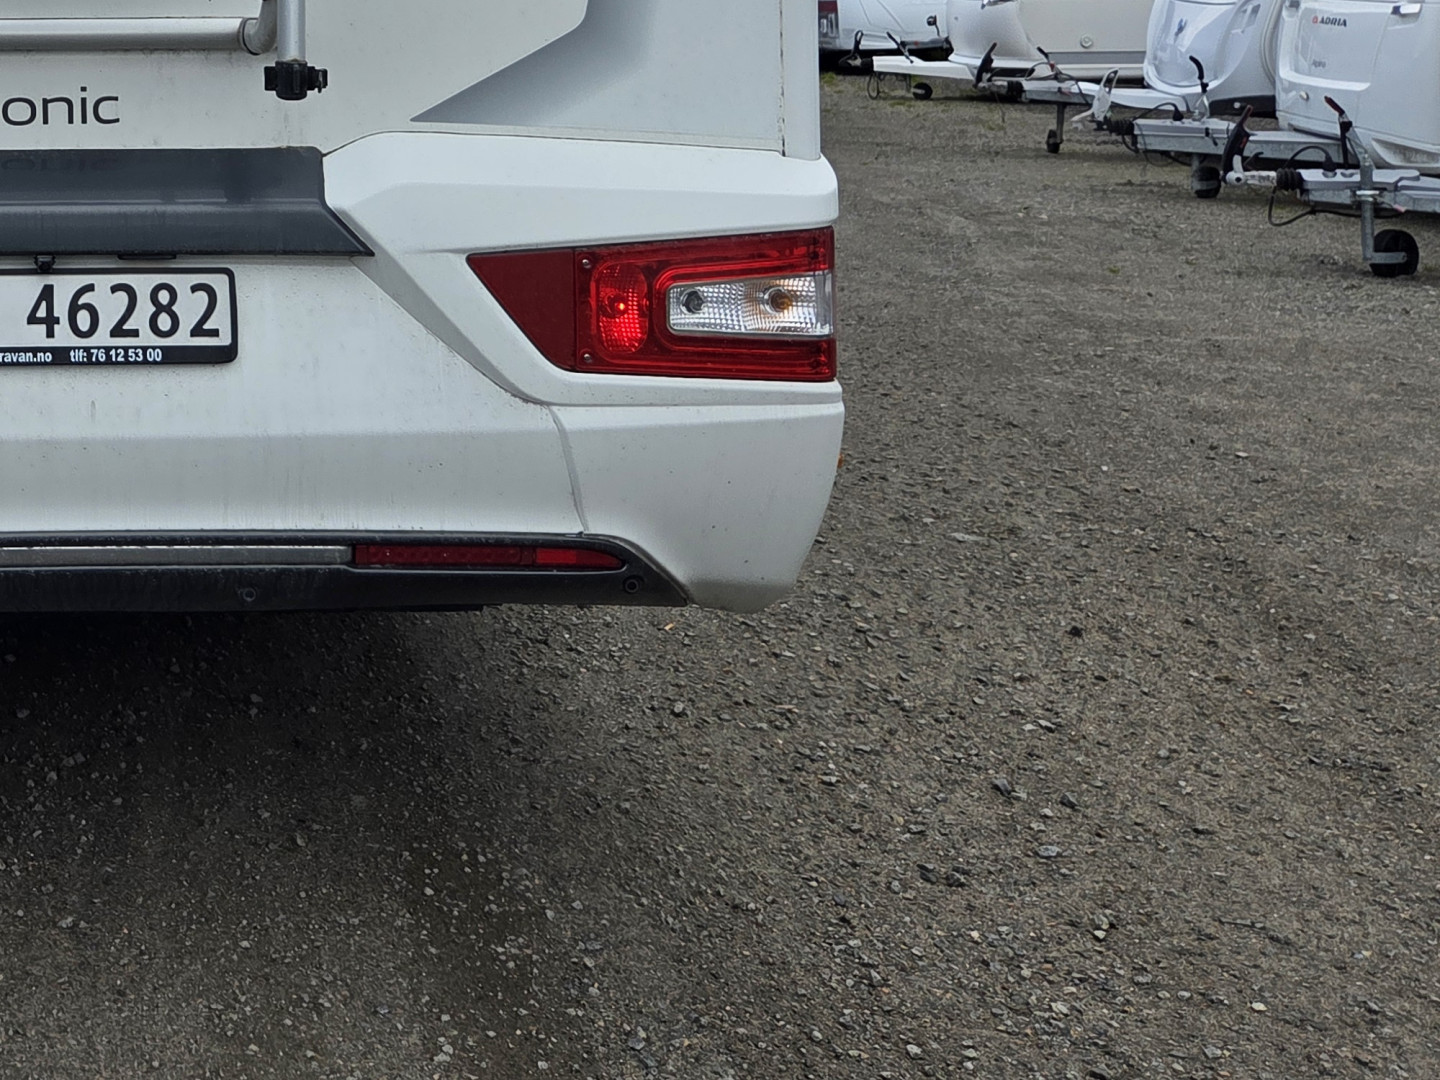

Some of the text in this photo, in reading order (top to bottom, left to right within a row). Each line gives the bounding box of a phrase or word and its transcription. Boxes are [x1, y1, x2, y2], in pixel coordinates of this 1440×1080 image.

[26, 282, 220, 339] 46282
[70, 349, 87, 363] tlf:
[90, 349, 106, 362] 76
[109, 349, 125, 362] 12
[127, 349, 144, 362] 53
[146, 348, 162, 362] 00
